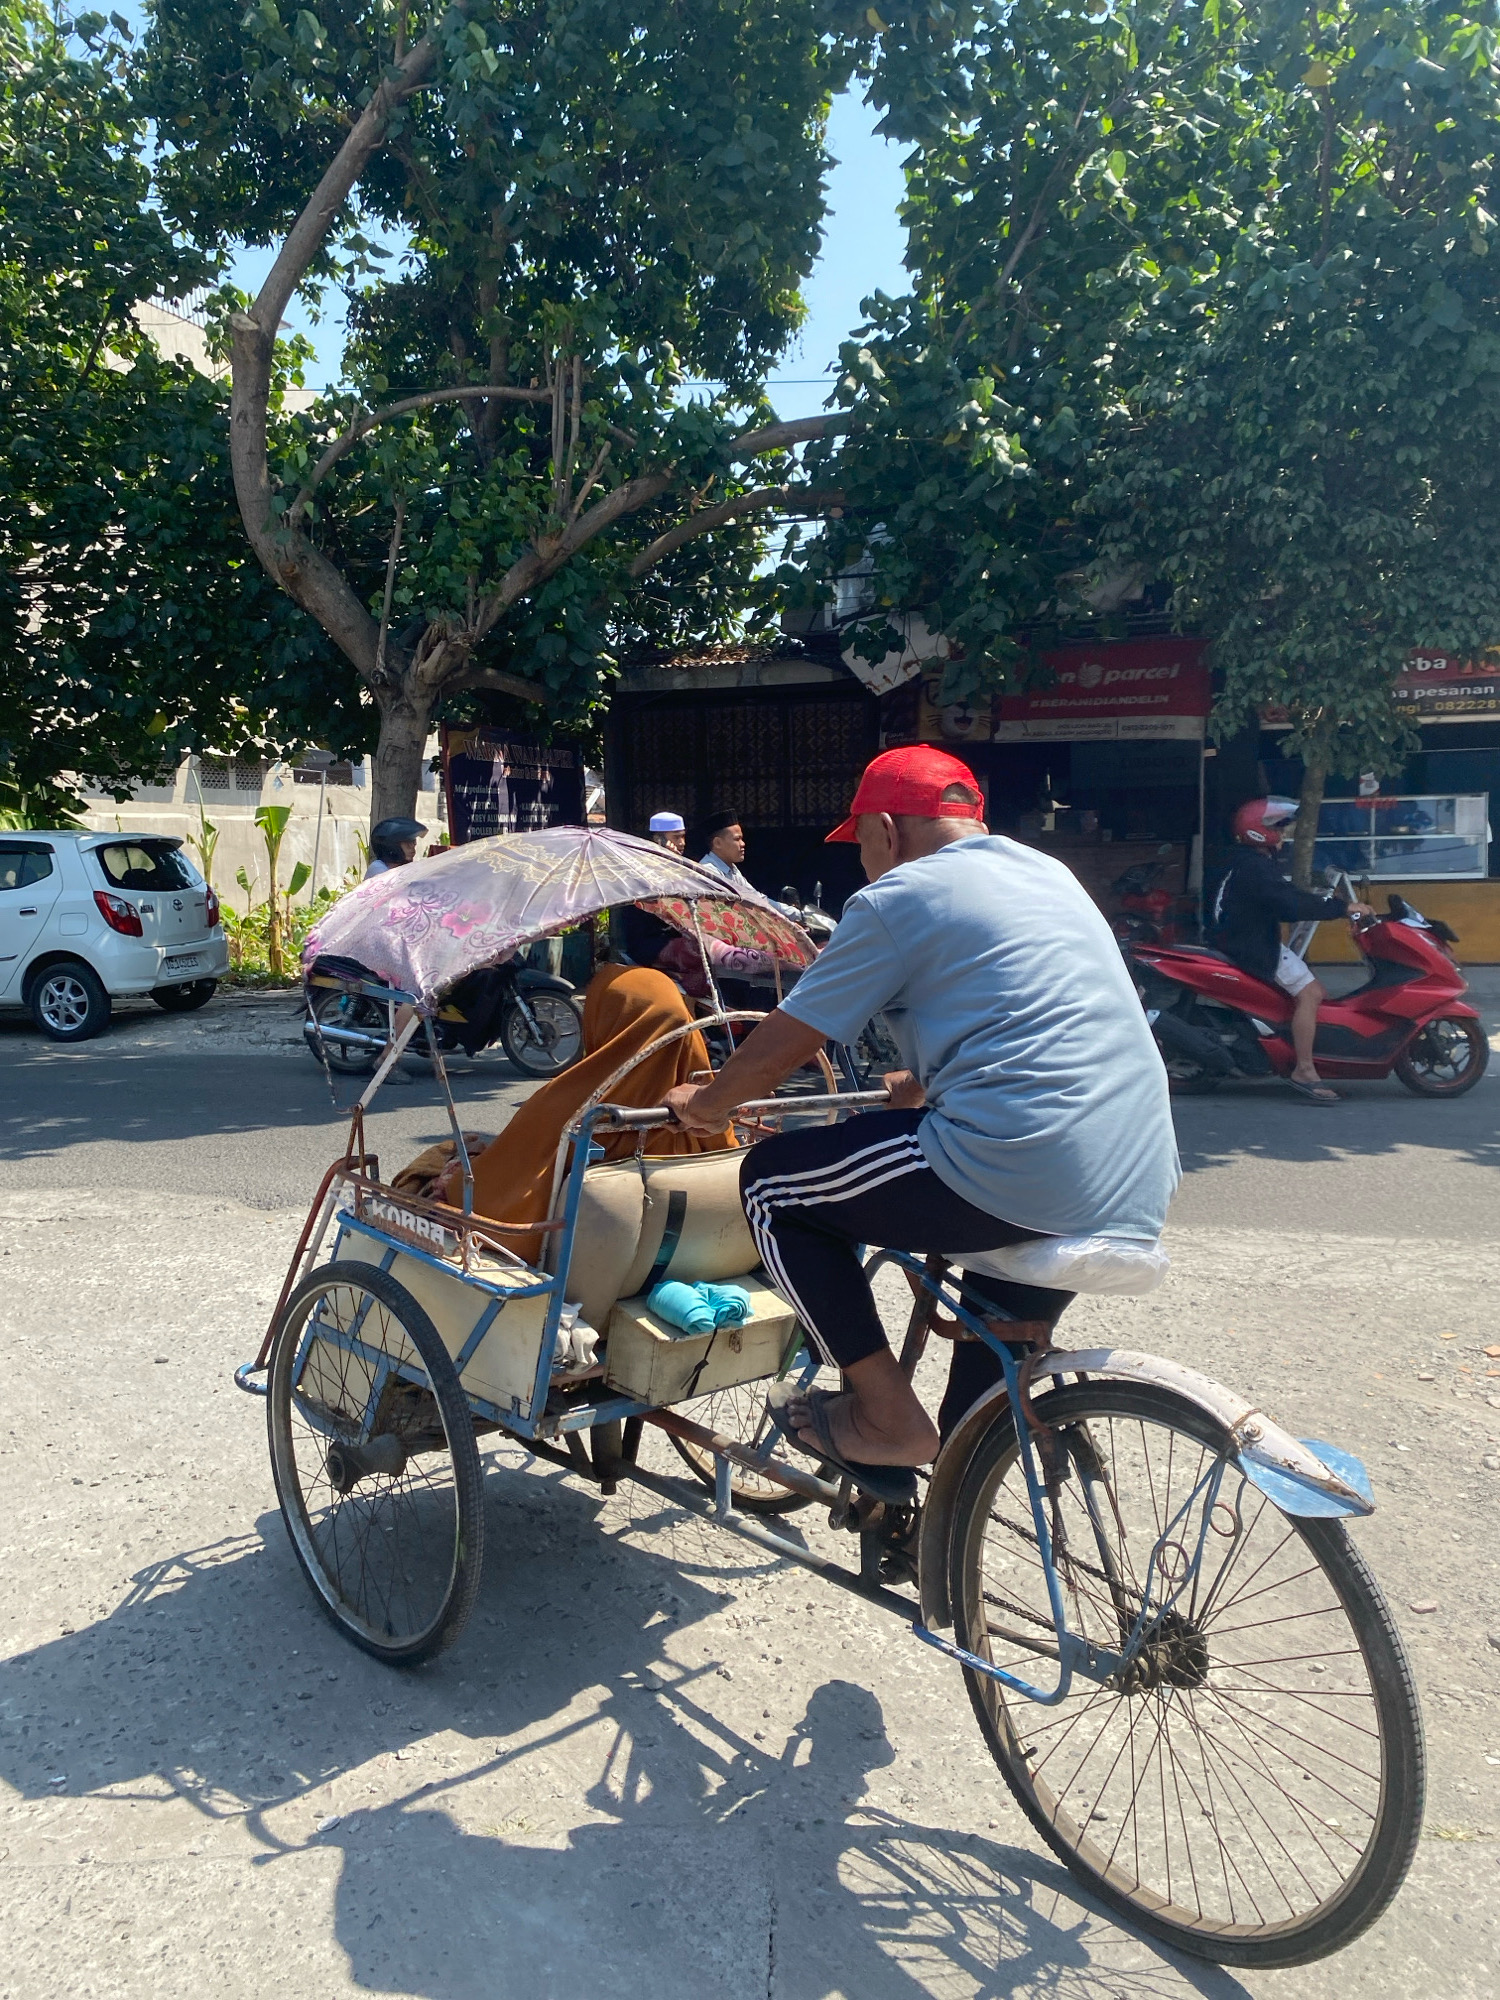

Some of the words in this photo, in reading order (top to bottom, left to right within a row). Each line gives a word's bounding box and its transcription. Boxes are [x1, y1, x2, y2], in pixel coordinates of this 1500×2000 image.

[1402, 656, 1447, 672] rba
[1103, 662, 1180, 685] parcel
[1414, 685, 1495, 700] pesanan
[1434, 699, 1500, 712] 082228
[511, 744, 575, 769] WALLPAPER
[469, 801, 498, 811] VERTICAL
